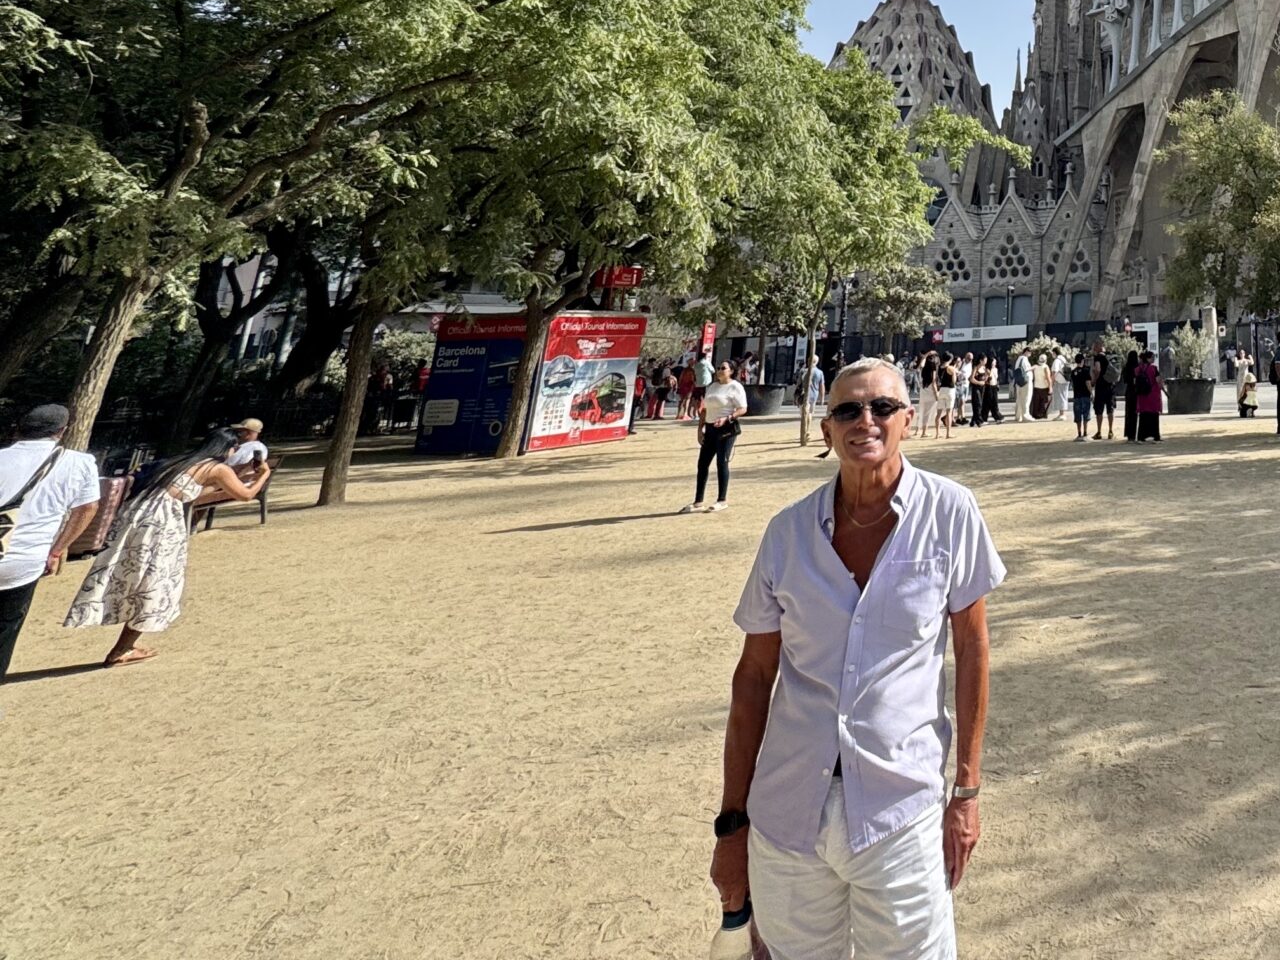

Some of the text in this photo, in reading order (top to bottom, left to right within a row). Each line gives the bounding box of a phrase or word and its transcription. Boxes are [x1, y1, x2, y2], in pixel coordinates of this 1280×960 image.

[584, 322, 605, 331] Tourist
[606, 321, 639, 330] Information
[438, 346, 486, 357] Barcelona
[436, 357, 459, 368] Card
